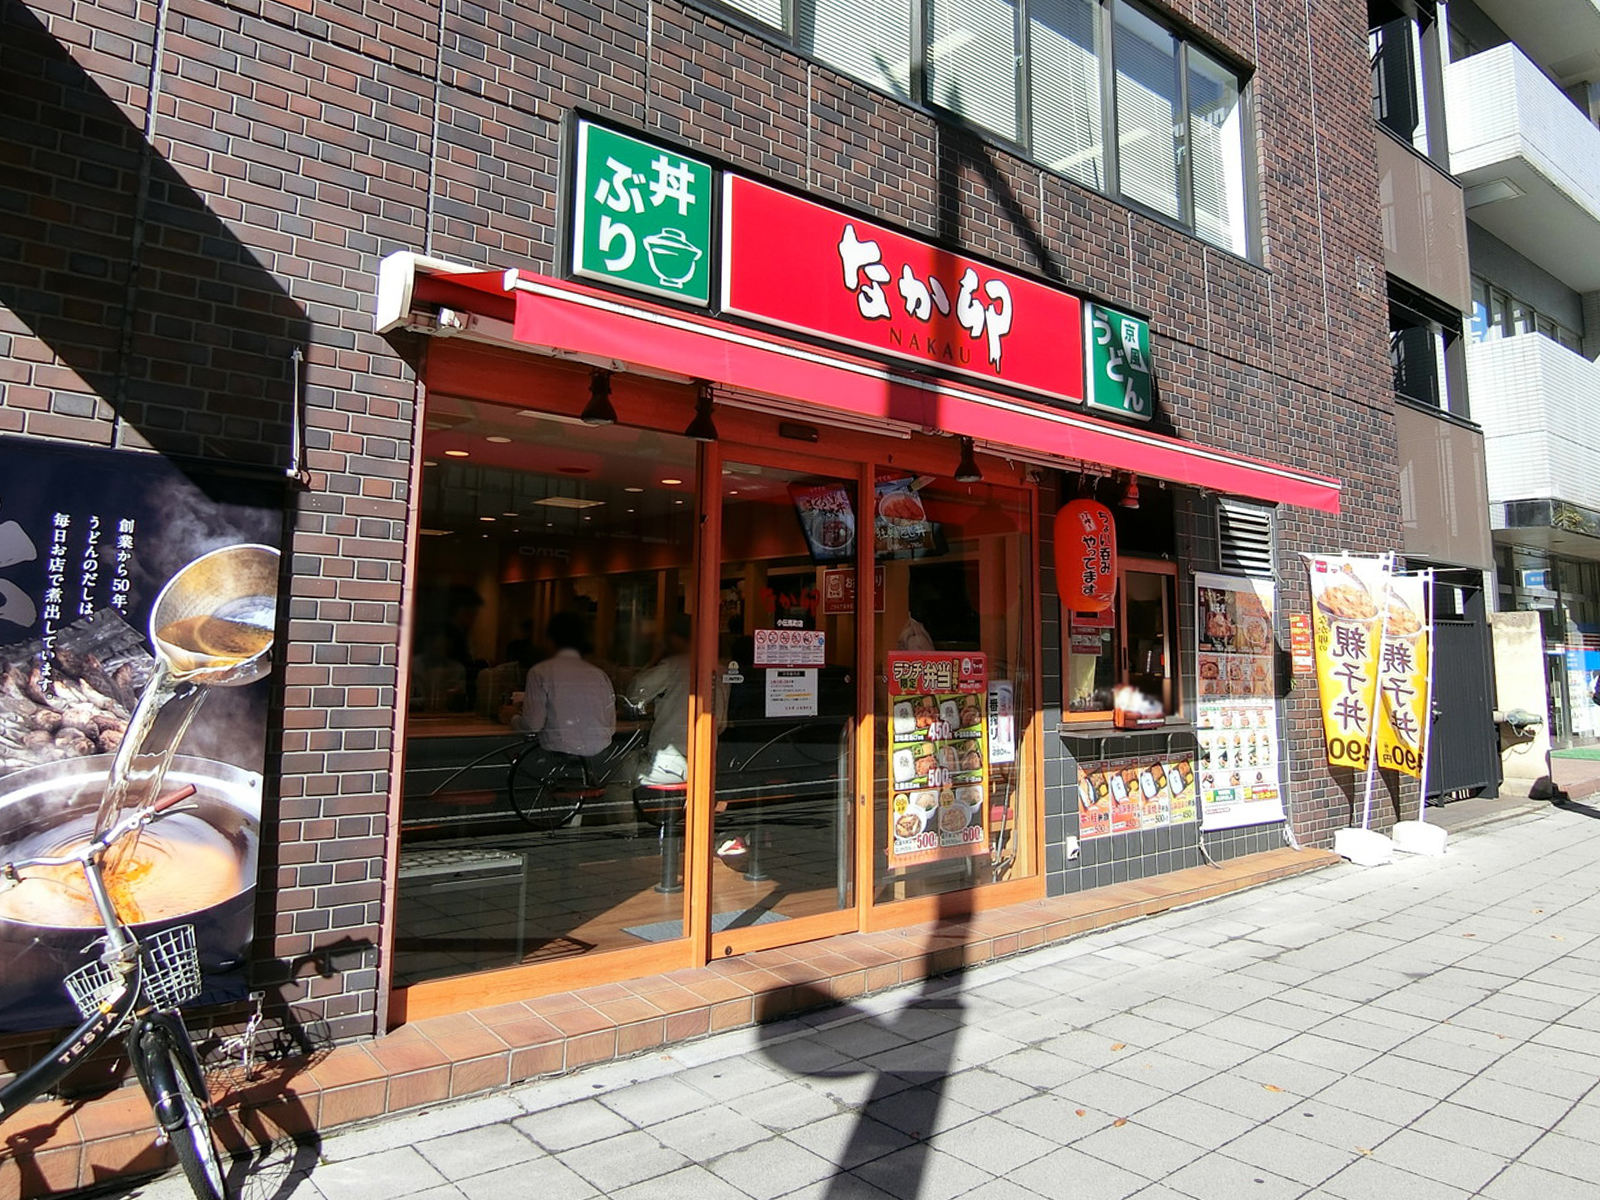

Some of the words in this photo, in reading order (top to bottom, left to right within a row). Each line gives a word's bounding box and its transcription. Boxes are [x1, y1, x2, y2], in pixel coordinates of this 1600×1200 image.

[837, 223, 1013, 373] なか卯
[889, 326, 972, 364] NAKAU
[1092, 309, 1144, 411] うどん
[79, 515, 102, 622] うどんのだしは、
[112, 518, 136, 616] 創業から50年、
[1082, 535, 1097, 597] やってます
[1097, 510, 1112, 576] ちょい呑み
[893, 660, 922, 680] ランチ
[923, 661, 953, 691] 弁当
